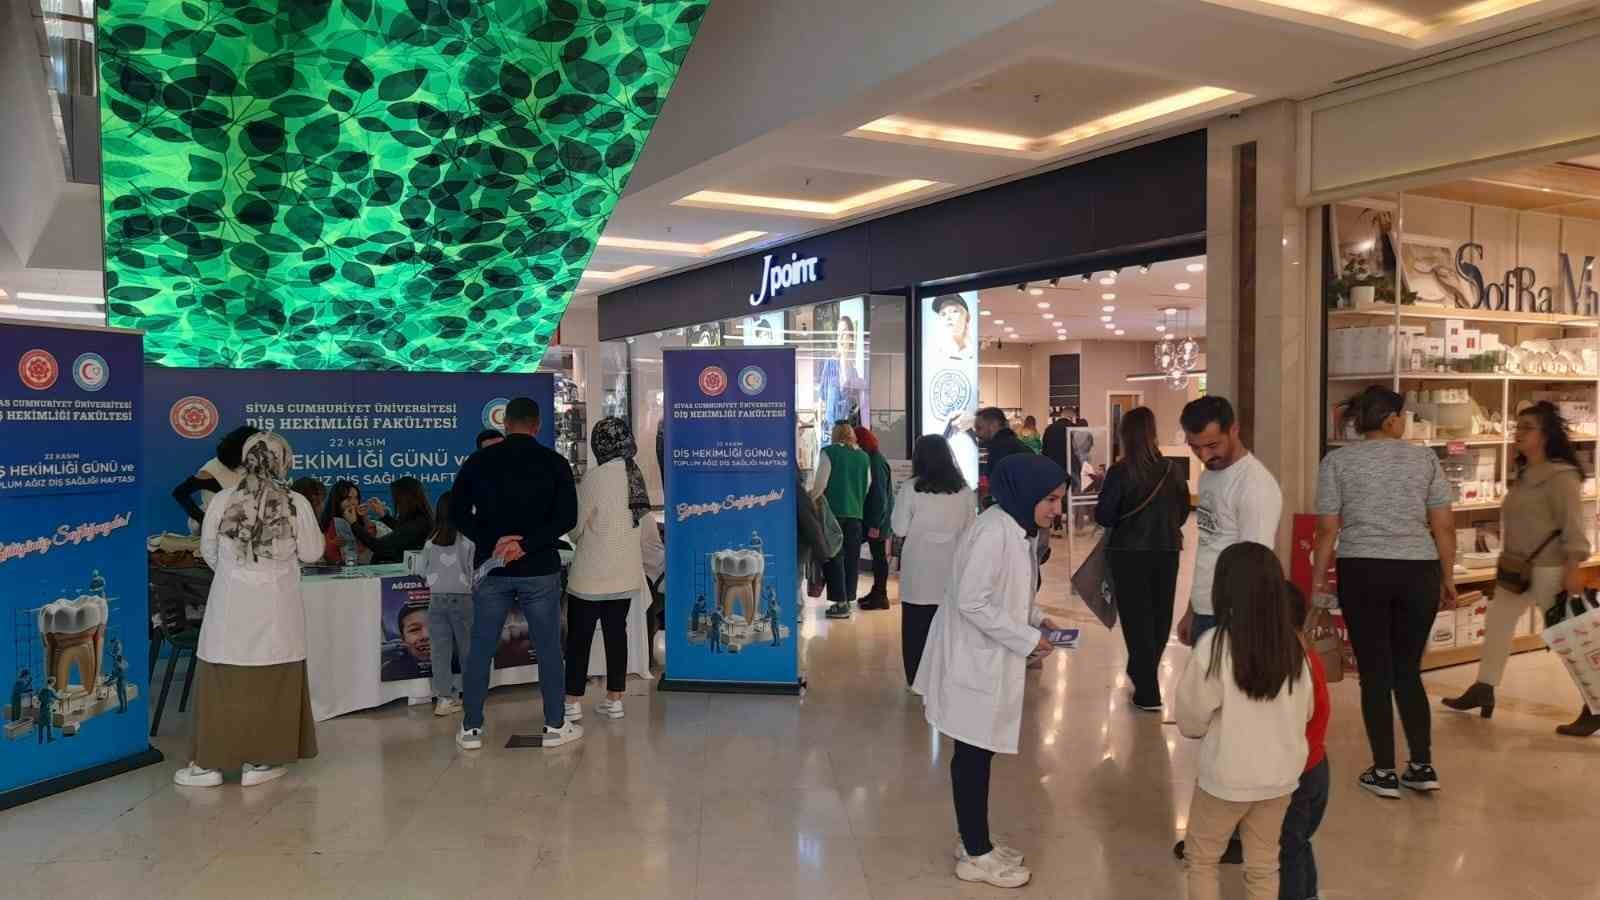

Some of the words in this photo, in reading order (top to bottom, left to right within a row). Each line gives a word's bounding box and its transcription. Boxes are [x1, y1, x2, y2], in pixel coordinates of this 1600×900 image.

[246, 401, 284, 413] SİVAS
[287, 401, 370, 413] CUMHURİYET
[375, 401, 457, 413] ÜNİVERSİTESİ
[7, 408, 71, 421] HEKİMLİĞİ
[72, 409, 132, 421] FAKÜLTESİ
[279, 414, 369, 430] HEKİMLİĞİ
[373, 414, 457, 429] FAKÜLTESİ
[329, 437, 345, 448] 22
[692, 447, 742, 458] HEKİMLİĞİ
[744, 447, 774, 458] GÜNÜ
[291, 450, 383, 470] EKİMLİĞİ
[390, 449, 448, 468] GÜNÜ
[10, 461, 79, 477] HEKİMLİĞİ
[81, 459, 118, 474] GÜNÜ
[120, 463, 135, 472] ve
[420, 472, 457, 484] HAFT
